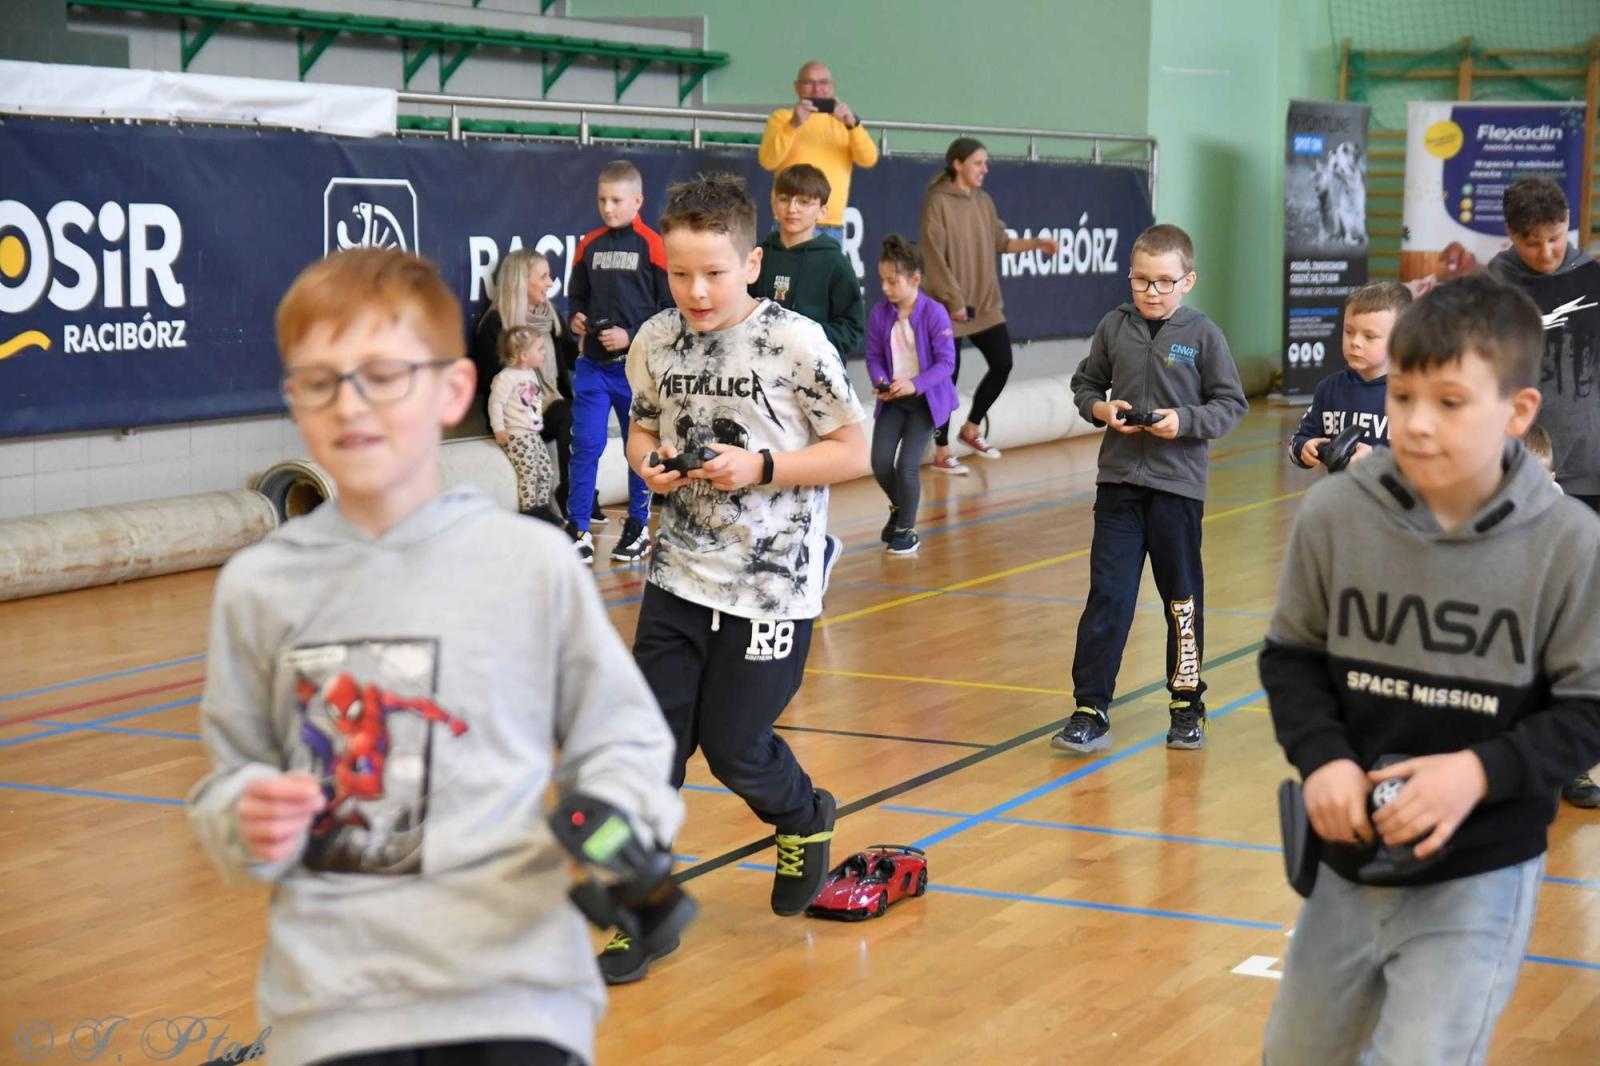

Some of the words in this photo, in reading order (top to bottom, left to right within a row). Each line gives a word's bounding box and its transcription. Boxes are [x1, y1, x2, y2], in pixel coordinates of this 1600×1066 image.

[1476, 124, 1563, 141] Flexadin
[592, 251, 640, 270] PUMA
[1001, 211, 1119, 277] RACIBÓRZ
[64, 313, 187, 353] RACIBÓRZ
[658, 365, 785, 433] METALLICA
[1322, 411, 1391, 440] BELIEV
[1173, 597, 1195, 636] FLY
[1338, 586, 1526, 664] NASA
[746, 619, 795, 660] R8
[1172, 637, 1199, 688] HIGH
[1347, 671, 1409, 699] SPACE
[1412, 684, 1499, 717] MISSION
